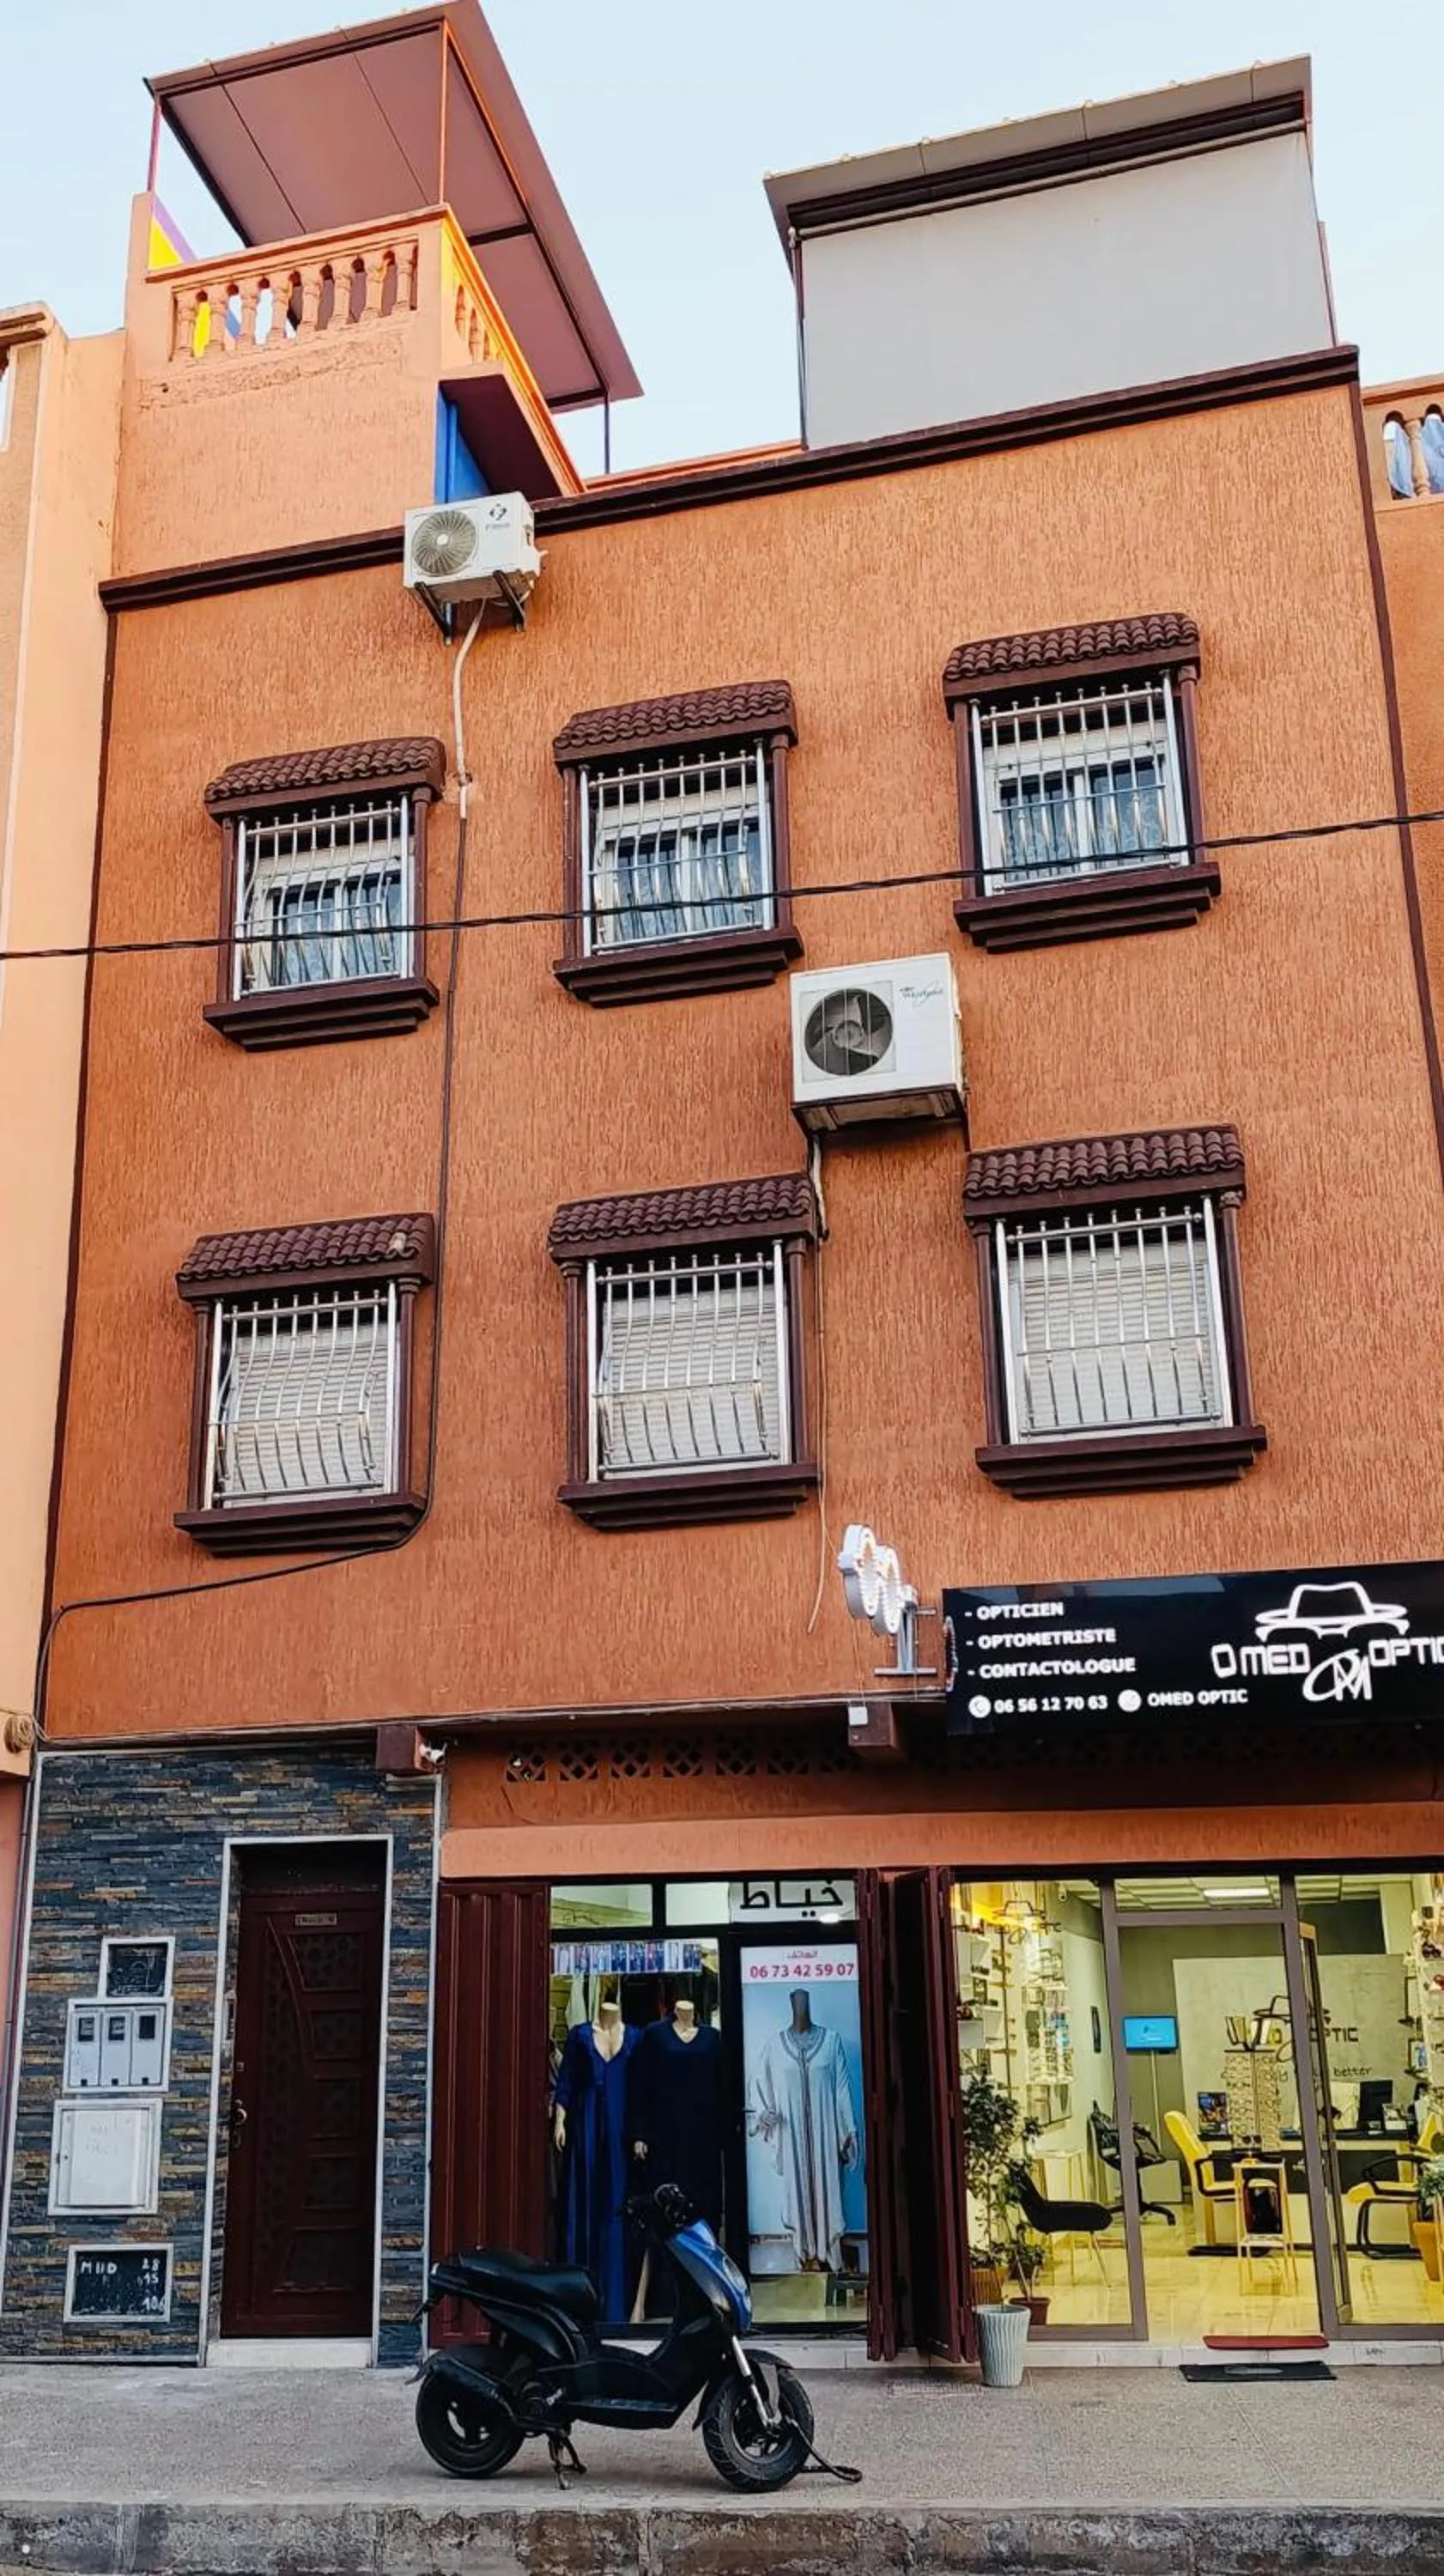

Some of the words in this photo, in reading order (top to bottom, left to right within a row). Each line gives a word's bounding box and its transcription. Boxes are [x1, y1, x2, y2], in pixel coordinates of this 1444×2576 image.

[976, 1601, 1065, 1620] OPTICIEN
[978, 1627, 1117, 1649] OPTOMETRISTE
[980, 1656, 1137, 1679] CONTACTOLOGUE
[993, 1698, 1015, 1714] 06
[1041, 1696, 1061, 1711] 12
[1064, 1696, 1085, 1710] 70
[1088, 1694, 1108, 1710] 63
[1147, 1691, 1194, 1707] OMED
[1197, 1688, 1249, 1705] OPTIC
[749, 1965, 768, 1978] 06
[772, 1965, 790, 1978] 73
[793, 1964, 811, 1978] 42
[815, 1963, 834, 1977] 59
[836, 1962, 854, 1976] 07
[1332, 2066, 1373, 2077] better
